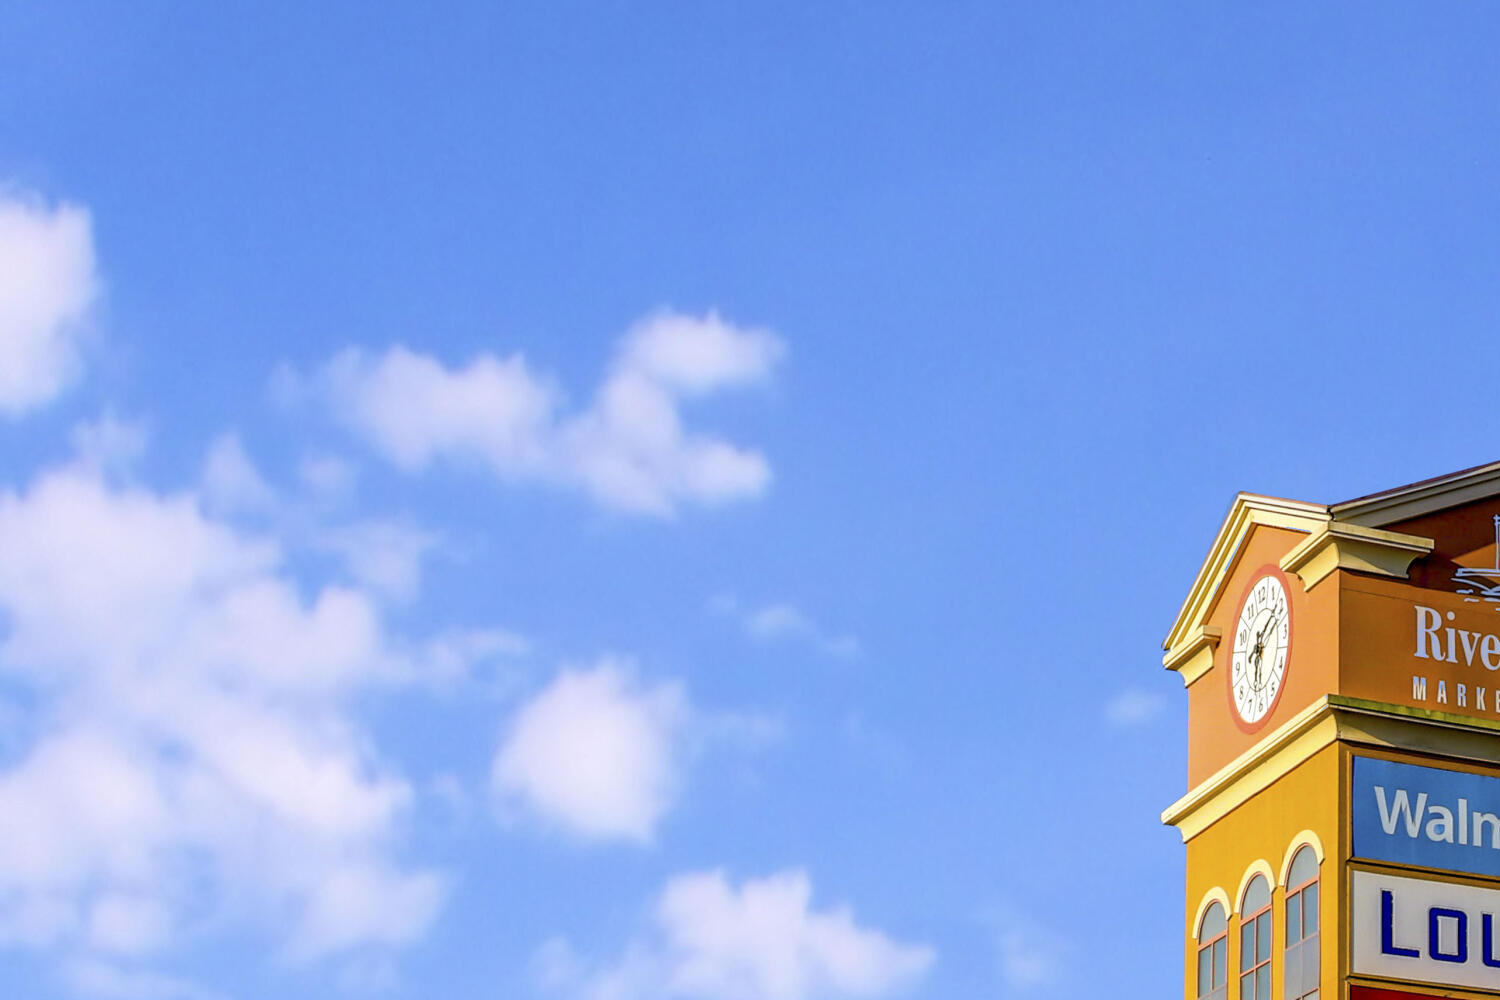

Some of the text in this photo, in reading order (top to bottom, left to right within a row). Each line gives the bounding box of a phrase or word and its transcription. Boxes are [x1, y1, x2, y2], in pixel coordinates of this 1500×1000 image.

[1258, 586, 1266, 603] 12
[1247, 604, 1255, 620] 11
[1278, 597, 1284, 615] 2
[1239, 628, 1247, 646] 10
[1282, 623, 1288, 640] 3
[1235, 662, 1241, 676] 9
[1278, 655, 1283, 670] 4
[1239, 685, 1244, 700] 8
[1270, 681, 1275, 697] 5
[1247, 699, 1253, 714] 7
[1258, 698, 1263, 713] 6
